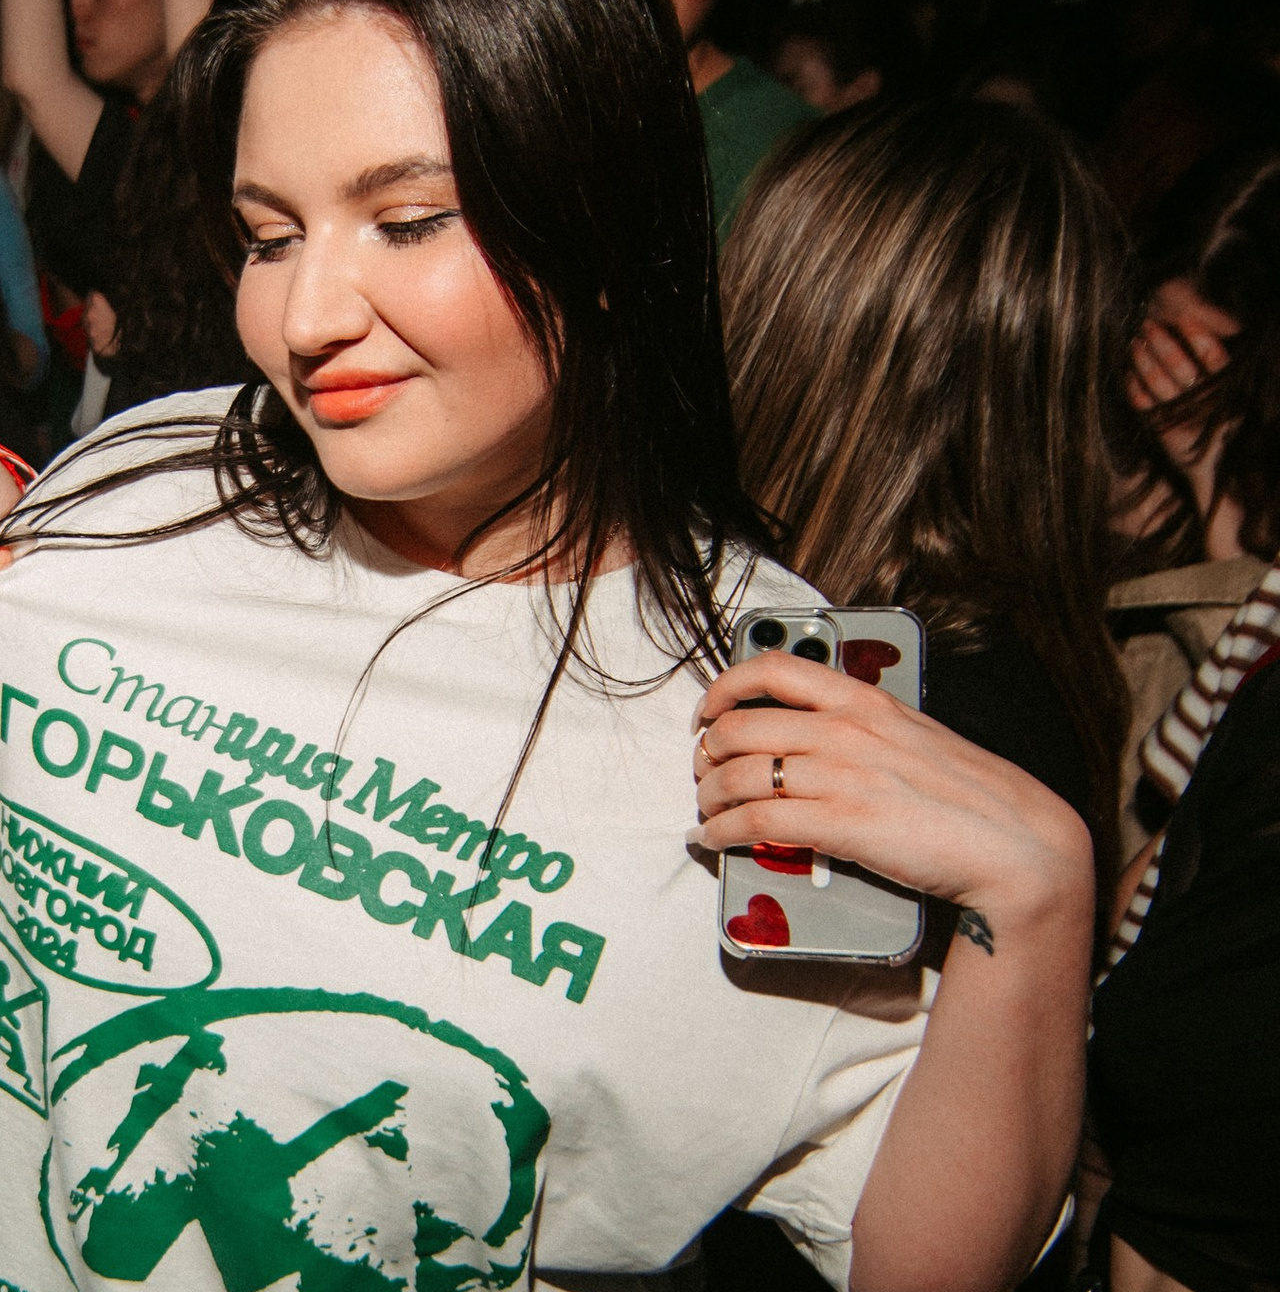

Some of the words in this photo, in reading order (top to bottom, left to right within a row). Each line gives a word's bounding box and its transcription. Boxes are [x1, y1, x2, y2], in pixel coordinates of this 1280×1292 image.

[0, 683, 607, 1005] ГОРЬКОВСКАЯ
[0, 805, 150, 921] НИЖНИЙ
[57, 637, 354, 800] Станция
[351, 756, 574, 893] Метро
